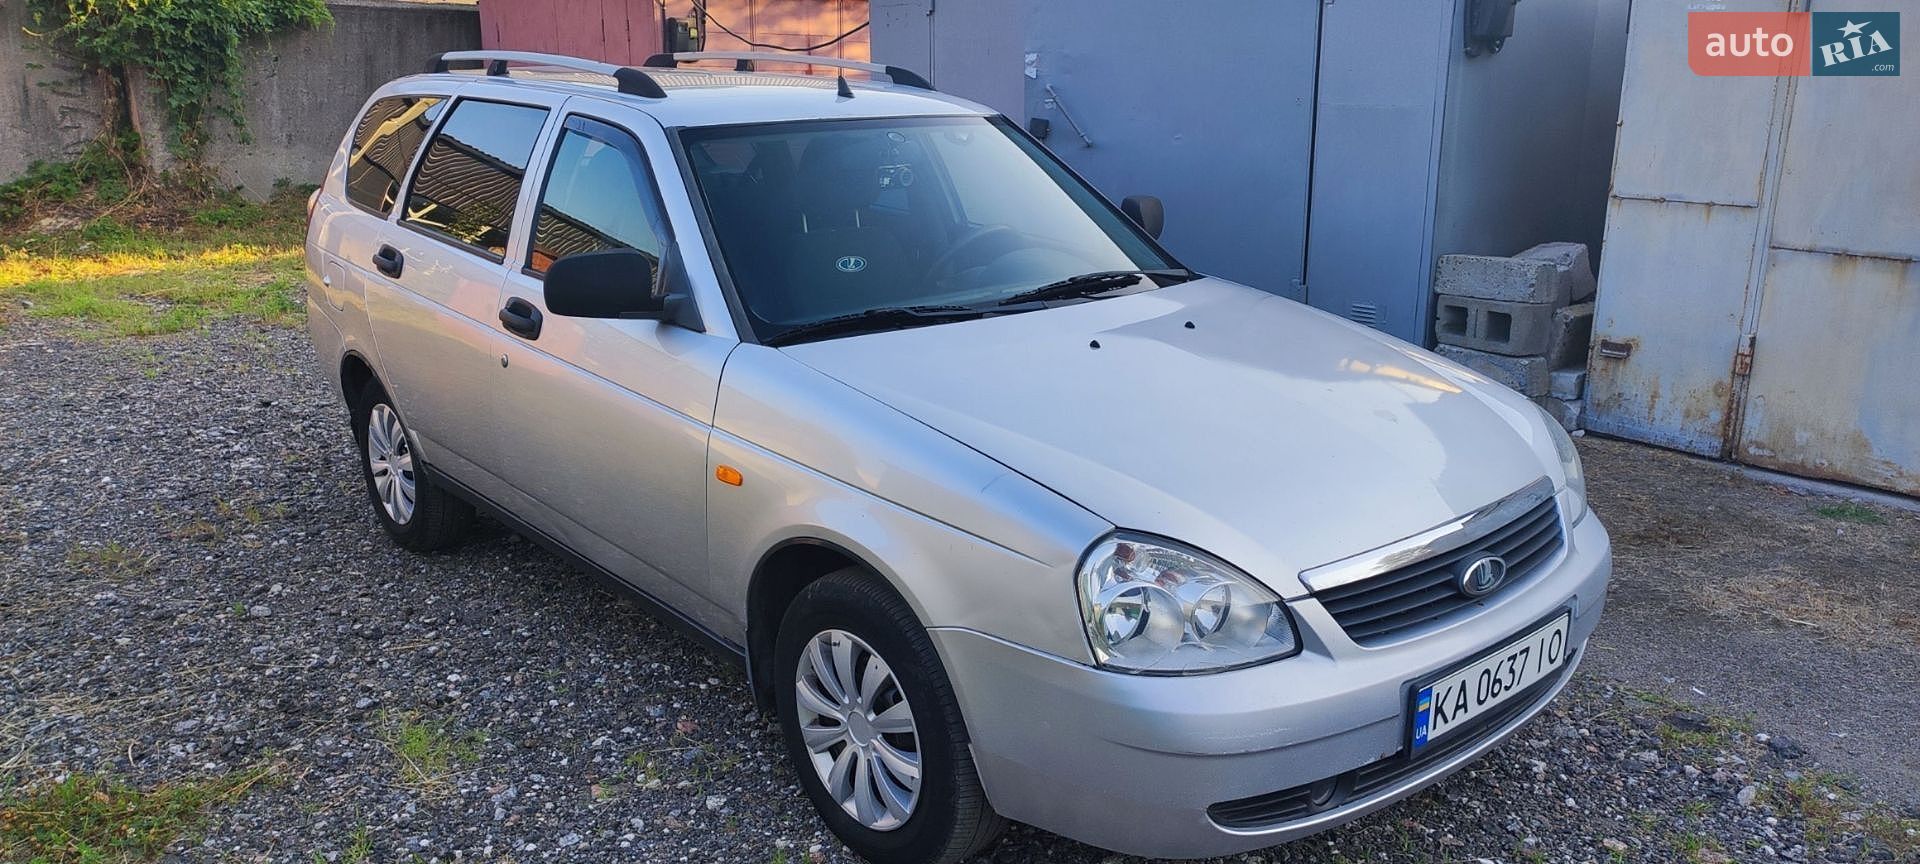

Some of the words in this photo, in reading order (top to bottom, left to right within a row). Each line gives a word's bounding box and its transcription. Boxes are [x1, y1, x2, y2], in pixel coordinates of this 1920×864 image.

[1432, 679, 1468, 730] KA
[1476, 646, 1530, 705] 0637
[1415, 726, 1427, 739] UA
